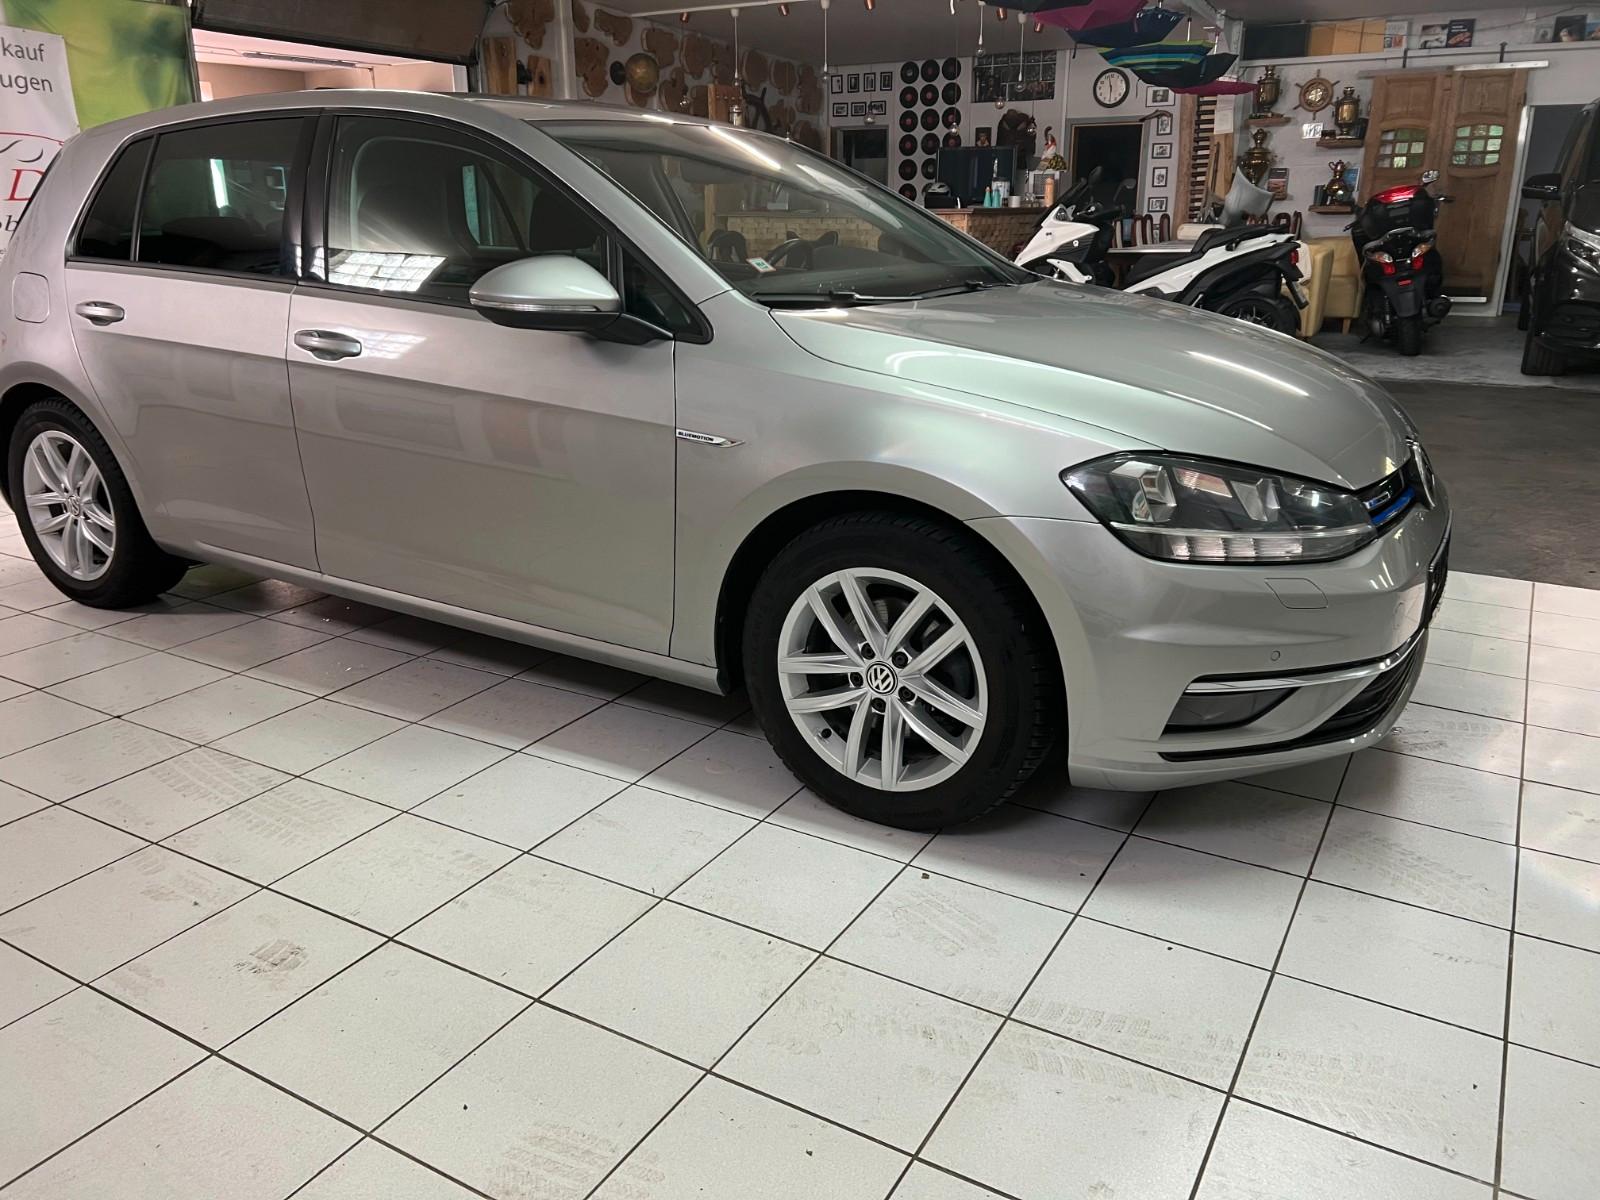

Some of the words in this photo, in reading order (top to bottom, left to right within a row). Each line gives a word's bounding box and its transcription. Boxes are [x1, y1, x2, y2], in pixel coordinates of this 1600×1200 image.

[1, 36, 45, 62] kauf
[0, 73, 53, 95] ugen
[677, 431, 714, 442] BLUEMOTION
